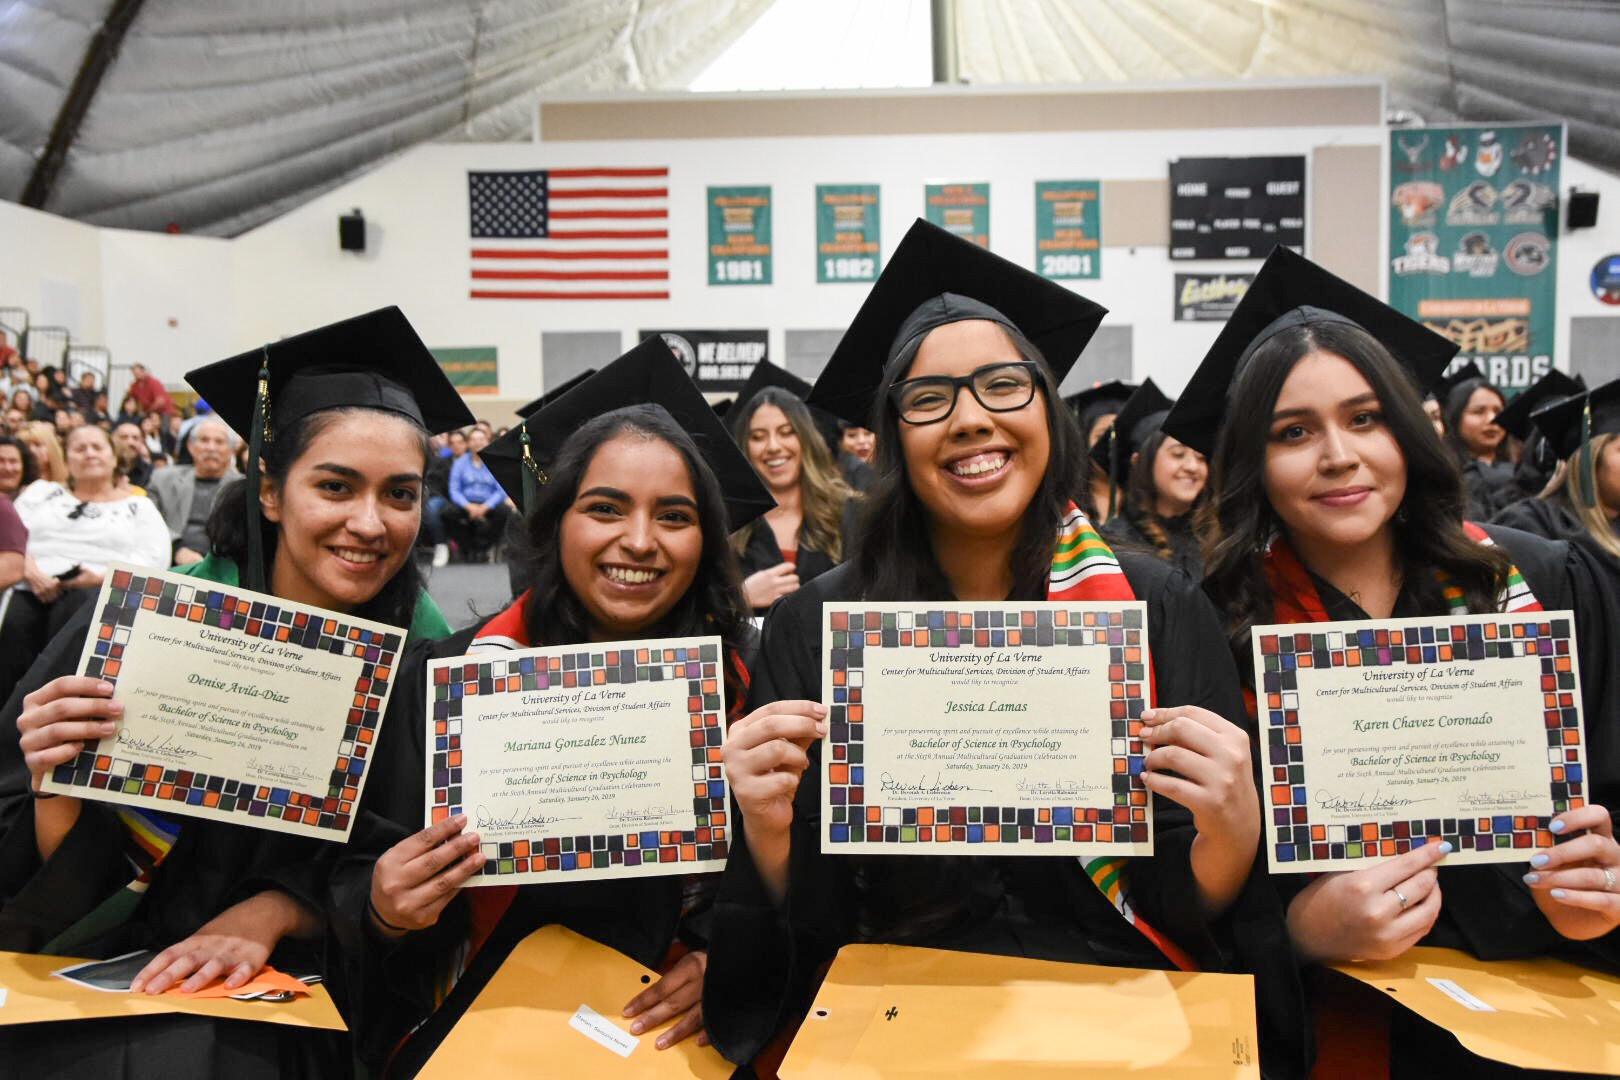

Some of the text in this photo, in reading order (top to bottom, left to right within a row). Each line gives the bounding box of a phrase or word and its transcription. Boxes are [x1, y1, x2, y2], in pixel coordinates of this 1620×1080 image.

[1042, 255, 1091, 276] 2001
[200, 630, 303, 661] University of La Verne
[149, 633, 341, 681] Center for Multicultural Services, Division of Student Affairs
[930, 652, 1042, 666] University of La Verne
[903, 668, 916, 678] for
[918, 667, 964, 675] Multicultural
[1027, 667, 1036, 677] of
[1036, 667, 1063, 675] Student
[1064, 667, 1090, 677] Affairs
[1363, 667, 1474, 682] University of La Verne
[188, 674, 289, 703] Denise Avila-Diaz
[1316, 689, 1339, 697] Center
[1337, 687, 1350, 698] for
[1352, 685, 1398, 694] Multicultural
[1400, 685, 1428, 693] Services,
[1461, 681, 1469, 691] of
[1470, 681, 1496, 689] Student
[1498, 679, 1523, 689] Affairs
[522, 690, 626, 705] University of La Verne
[497, 712, 509, 721] for
[511, 708, 554, 717] Multicultural
[555, 707, 581, 715] Services,
[613, 703, 620, 713] of
[621, 702, 646, 710] Student
[647, 701, 671, 710] Affairs
[945, 701, 1027, 714] Jessica Lamas
[158, 704, 298, 741] Bachelor of Science in Psychology
[1353, 712, 1493, 732] Karen Chavez Coronado
[187, 731, 212, 742] Saturday,
[215, 737, 238, 747] January
[249, 743, 262, 751] 2019
[504, 735, 646, 752] Mariana Gonzalez Nunez
[909, 738, 1061, 752] Bachelor of Science in Psychology
[946, 763, 974, 771] Saturday,
[976, 763, 1000, 771] January
[1351, 750, 1500, 767] Bachelor of Science in Psychology
[505, 769, 647, 786] Bachelor of Science in Psychology
